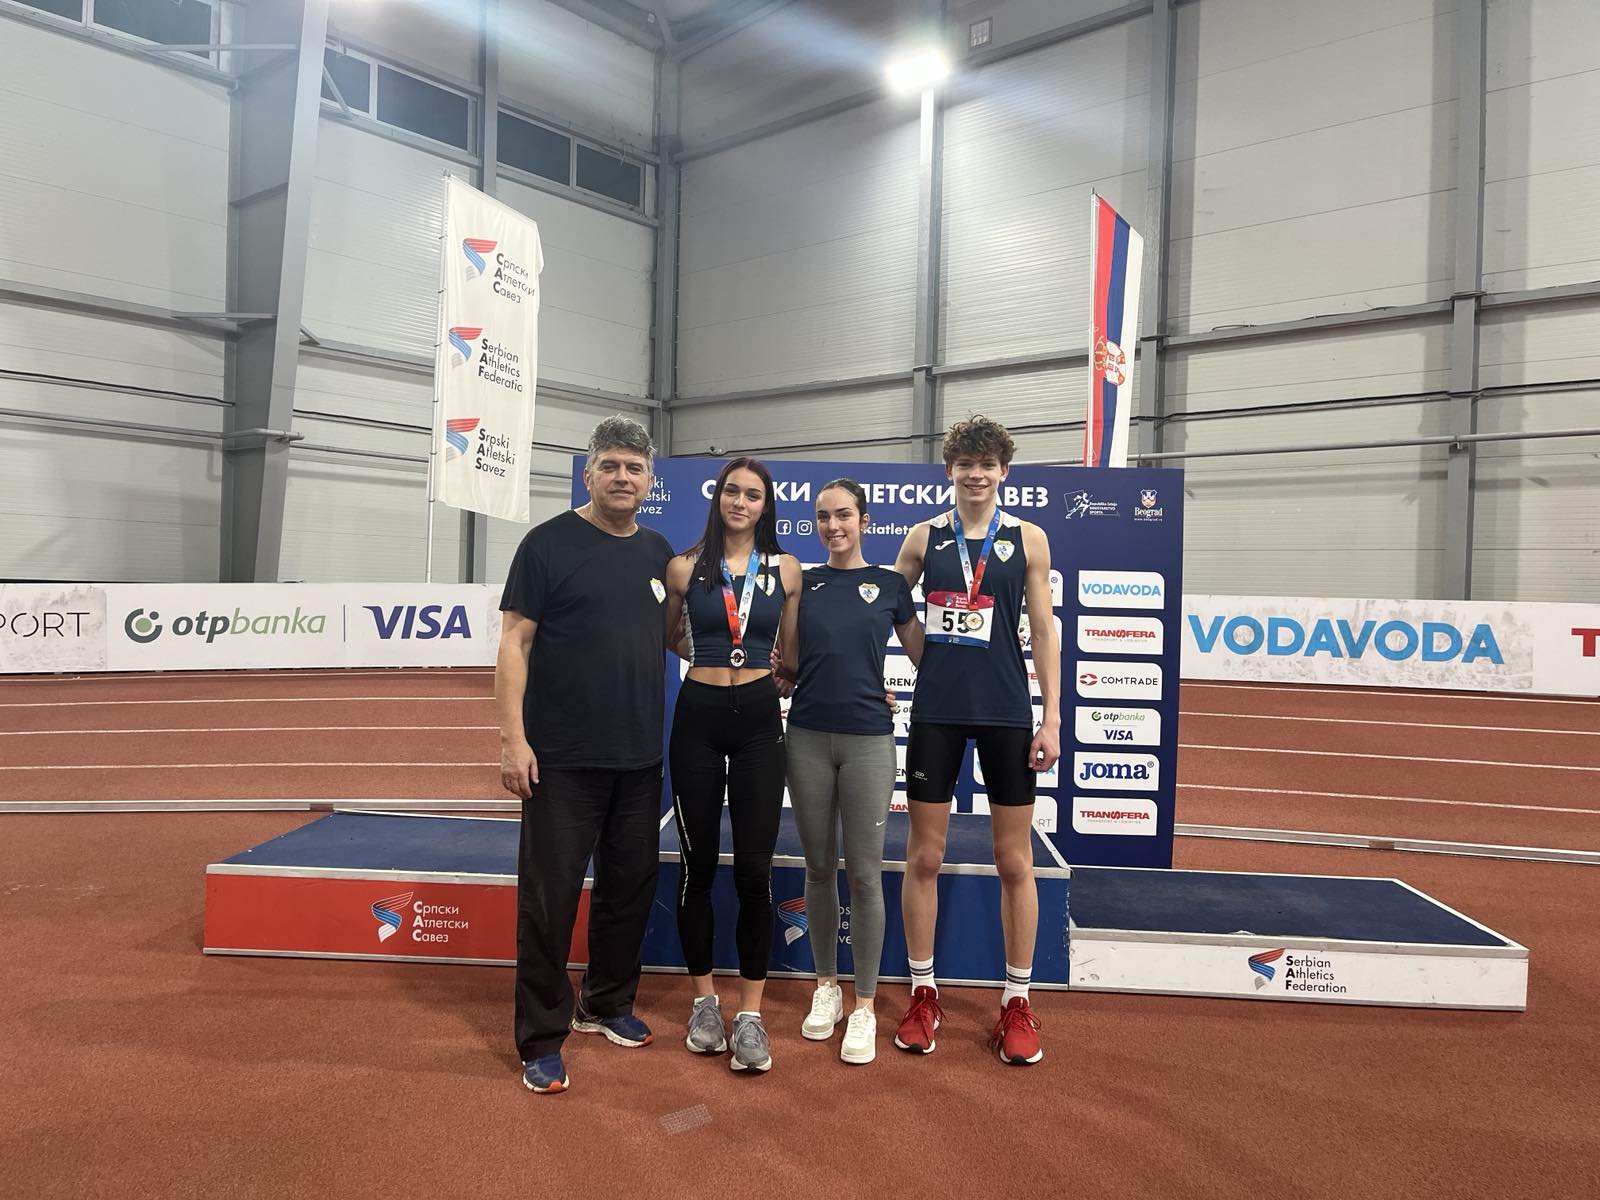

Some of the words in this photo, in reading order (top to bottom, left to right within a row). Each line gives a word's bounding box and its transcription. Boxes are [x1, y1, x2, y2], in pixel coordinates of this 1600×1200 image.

[493, 280, 522, 304] Савез
[481, 338, 519, 363] Serbian
[479, 352, 521, 378] Athletics
[478, 365, 523, 392] Federatio
[478, 428, 510, 450] Srpski
[476, 442, 516, 465] Atletski
[475, 457, 505, 478] Savez
[1134, 507, 1163, 519] Beograd
[1081, 583, 1161, 597] VODAVODA
[171, 607, 326, 644] otpbanka
[362, 605, 472, 640] VISA
[1085, 629, 1156, 638] TRANSFERA
[1187, 615, 1505, 664] VODAVODA
[1101, 676, 1158, 686] COMTRADE
[1103, 711, 1145, 723] otpbanka
[1103, 729, 1134, 741] VISA
[1080, 810, 1150, 820] TRANSFERA
[413, 901, 459, 917] Српски
[412, 915, 469, 929] Атлетски
[412, 929, 449, 943] Савез
[1285, 954, 1331, 968] Serbian
[1285, 967, 1335, 981] Athletics
[1285, 979, 1347, 993] Federation
